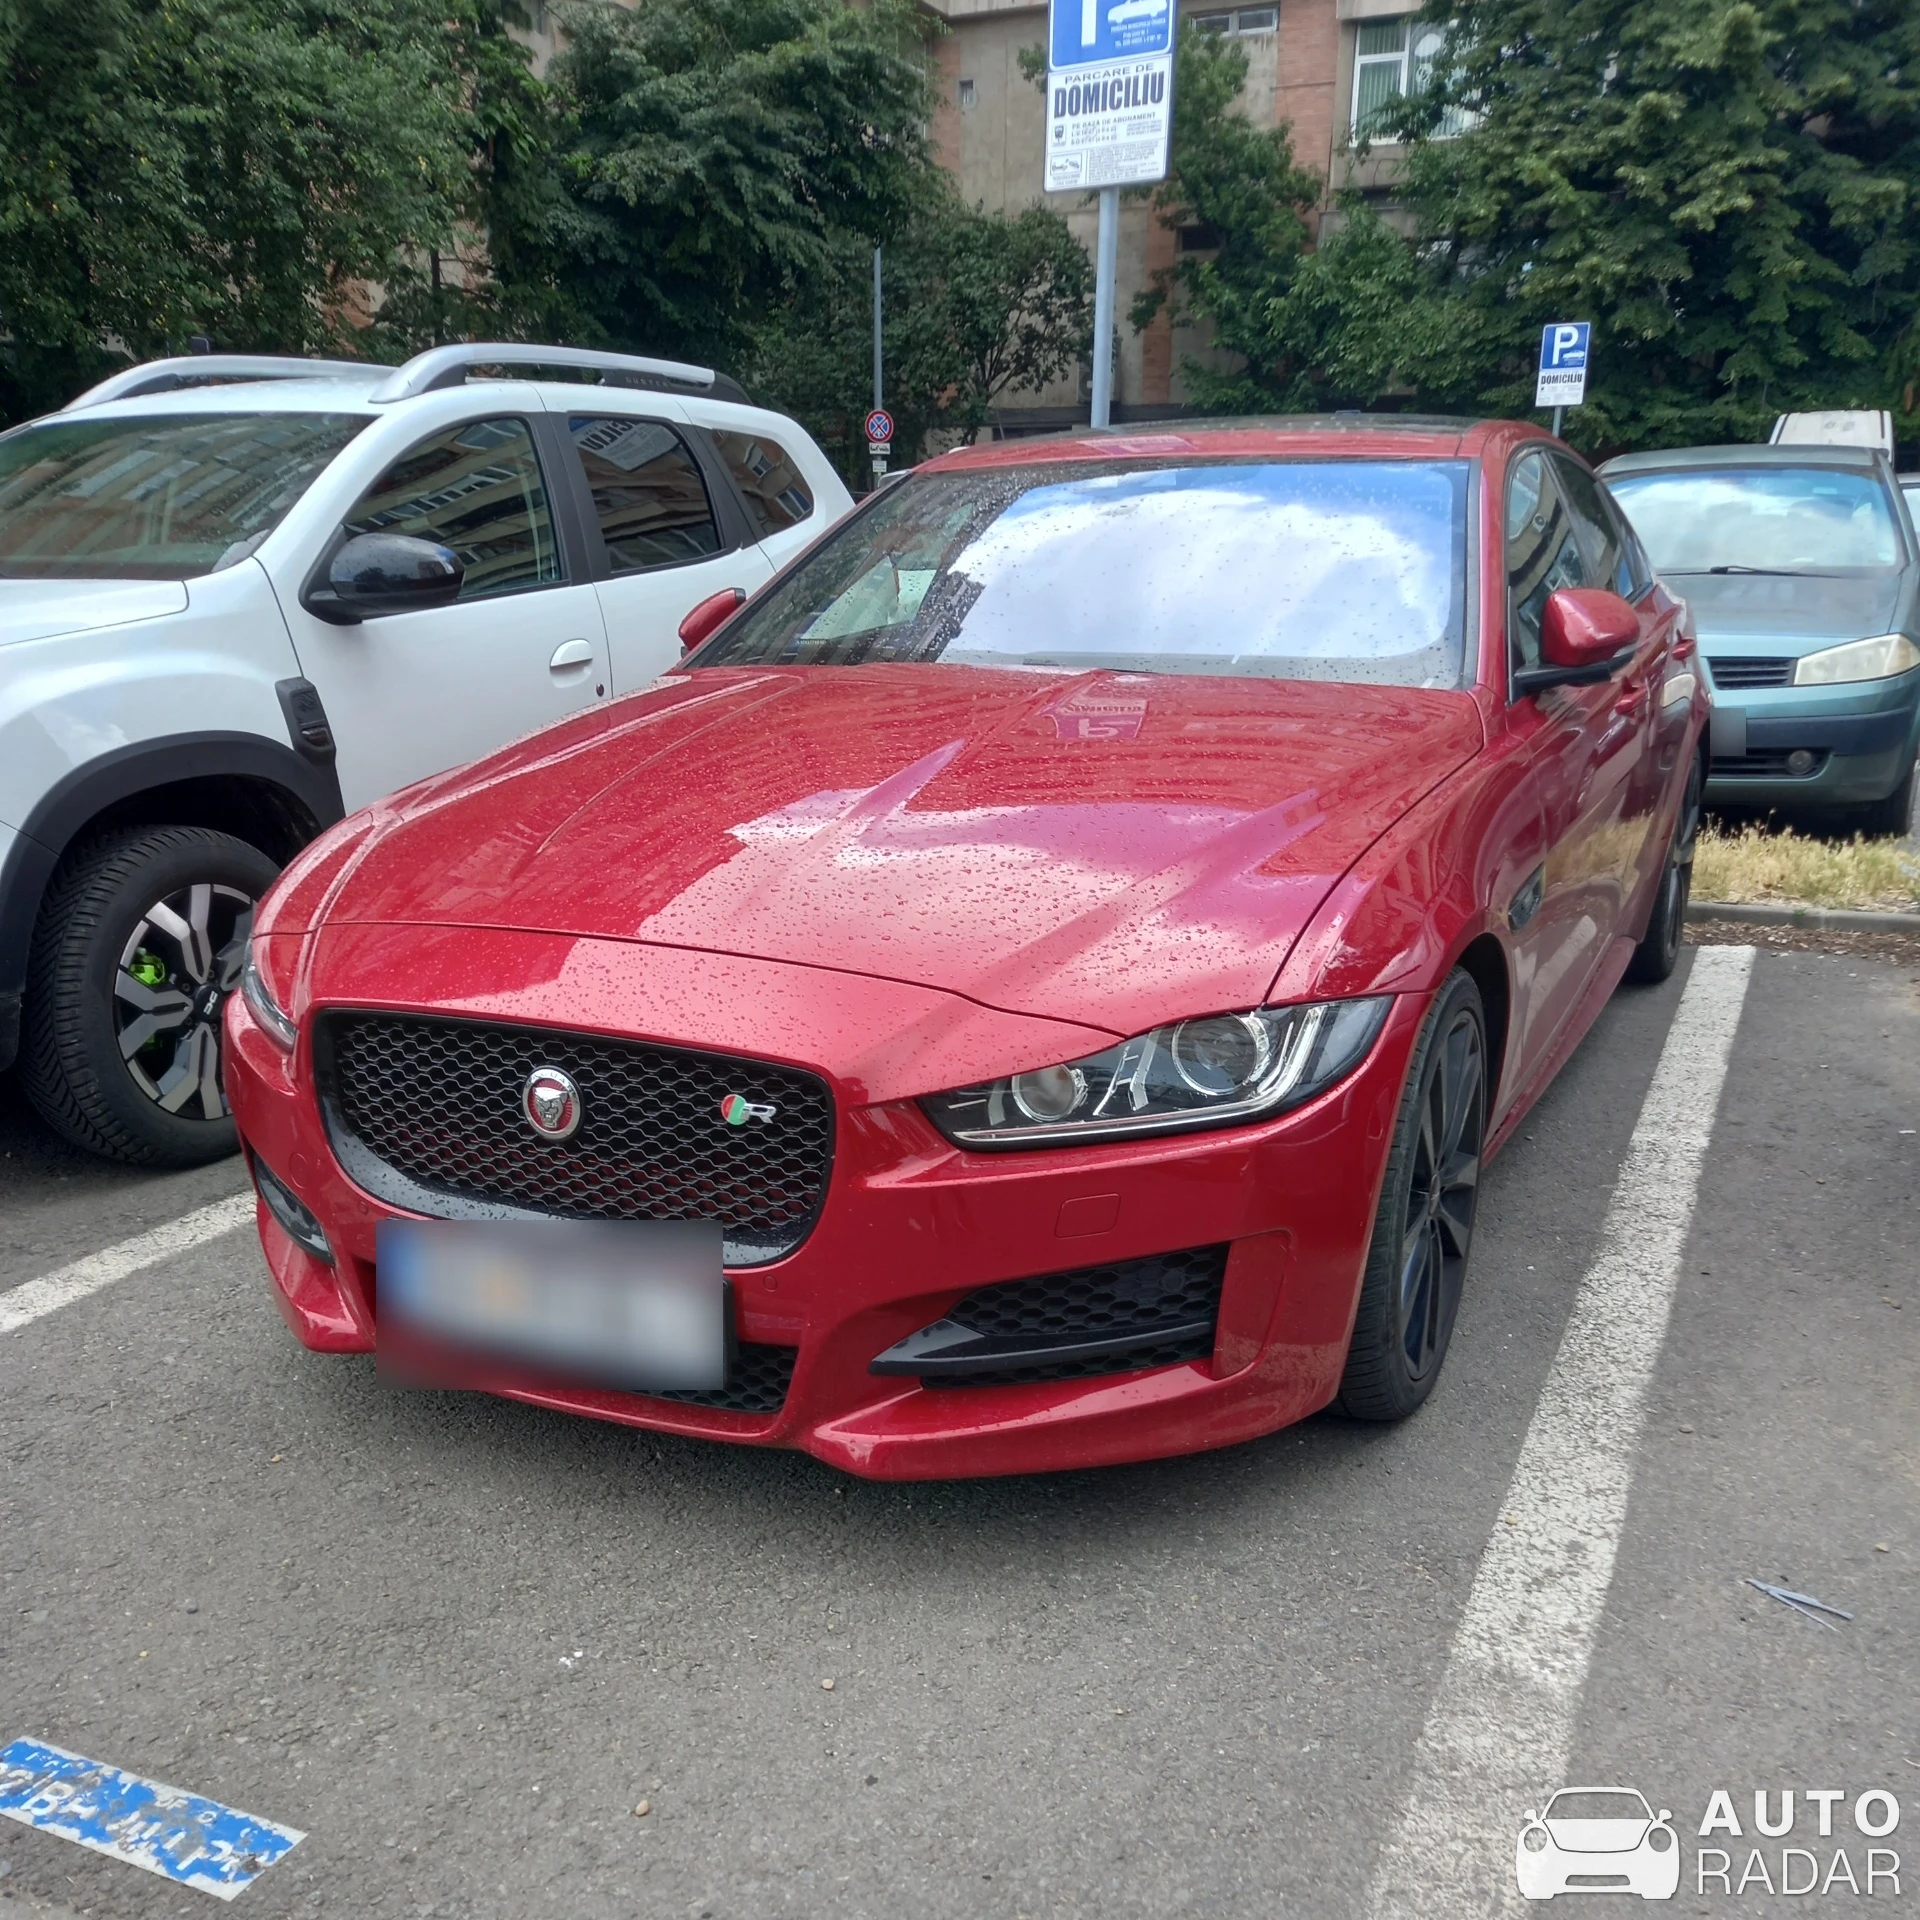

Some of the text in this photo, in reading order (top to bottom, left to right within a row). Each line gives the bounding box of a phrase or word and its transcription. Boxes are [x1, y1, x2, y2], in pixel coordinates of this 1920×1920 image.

[1065, 63, 1154, 84] PARCARE DE
[1054, 71, 1165, 119] DOMICILIU
[1552, 325, 1579, 365] P
[625, 376, 670, 388] DUSTER
[1541, 373, 1583, 385] DOMICILIU
